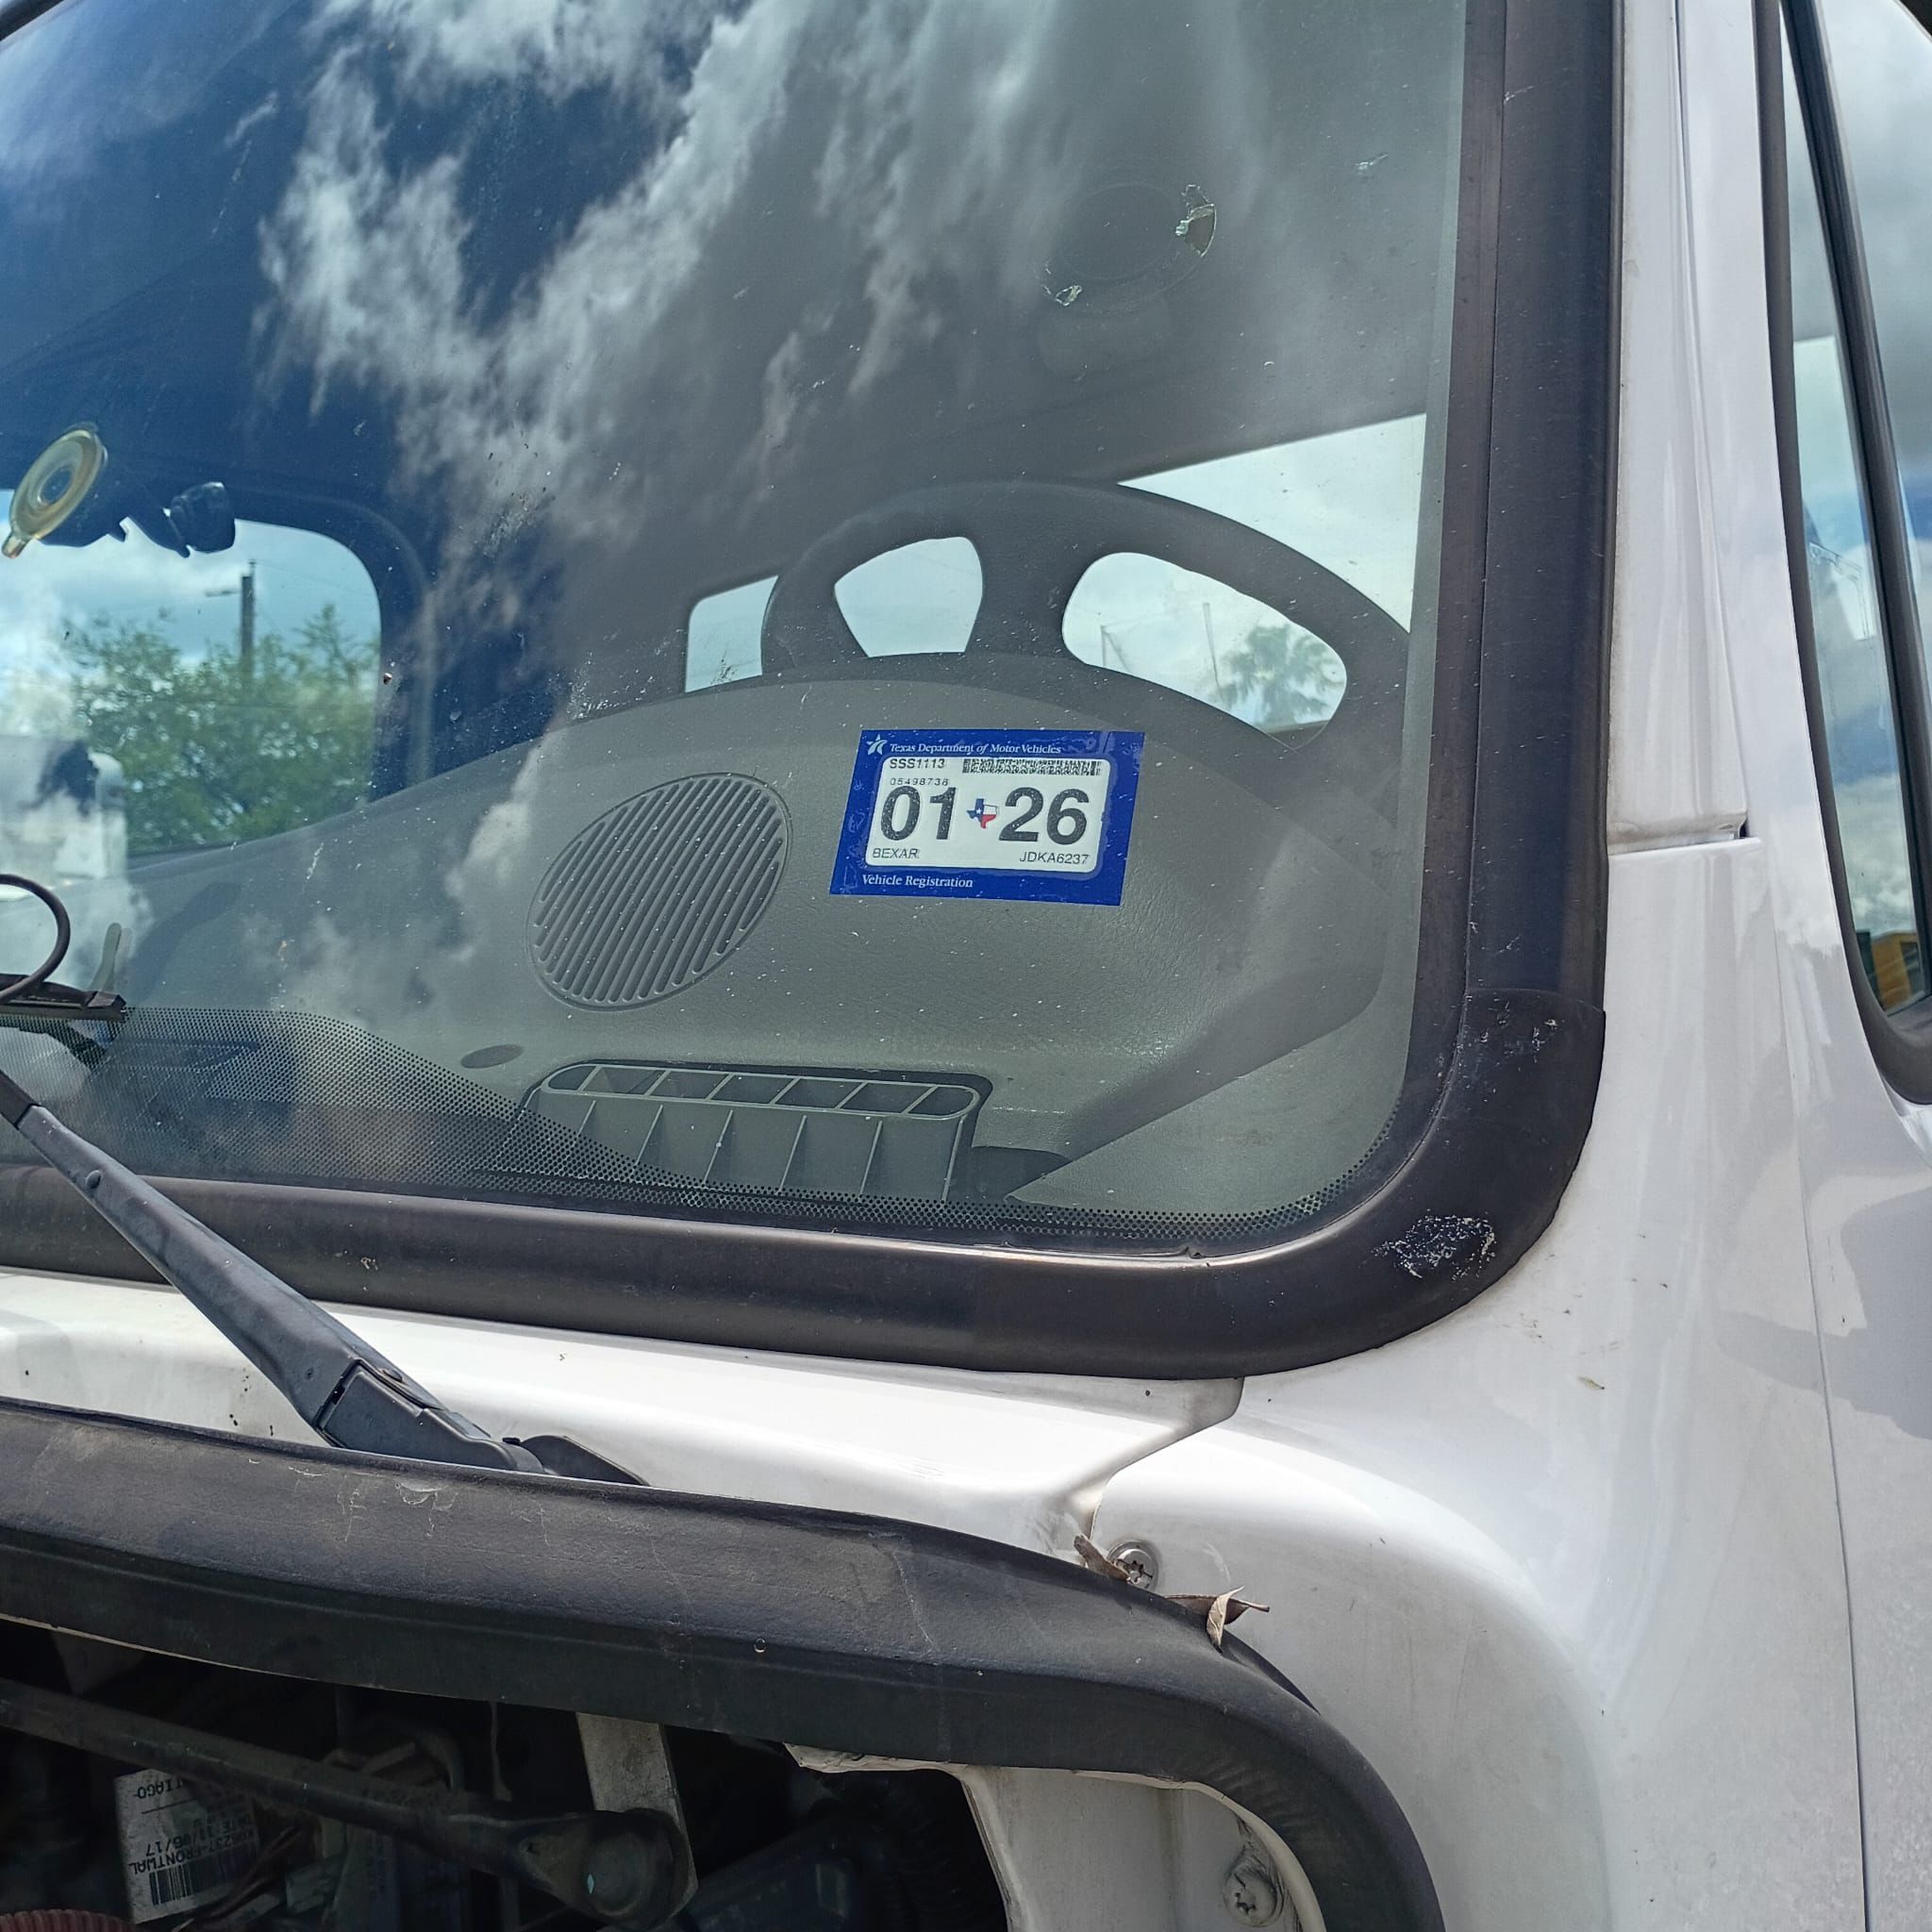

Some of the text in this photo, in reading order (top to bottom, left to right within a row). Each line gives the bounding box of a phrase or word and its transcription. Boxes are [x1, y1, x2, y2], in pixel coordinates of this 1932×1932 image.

[890, 742, 1062, 755] Texas Department of Motor Vehicles
[890, 758, 945, 769] SSS1113
[880, 785, 1090, 846] 01 26
[873, 847, 921, 859] BEXAR
[1019, 851, 1090, 865] JDKA6237
[862, 874, 974, 888] Vehicle Registration
